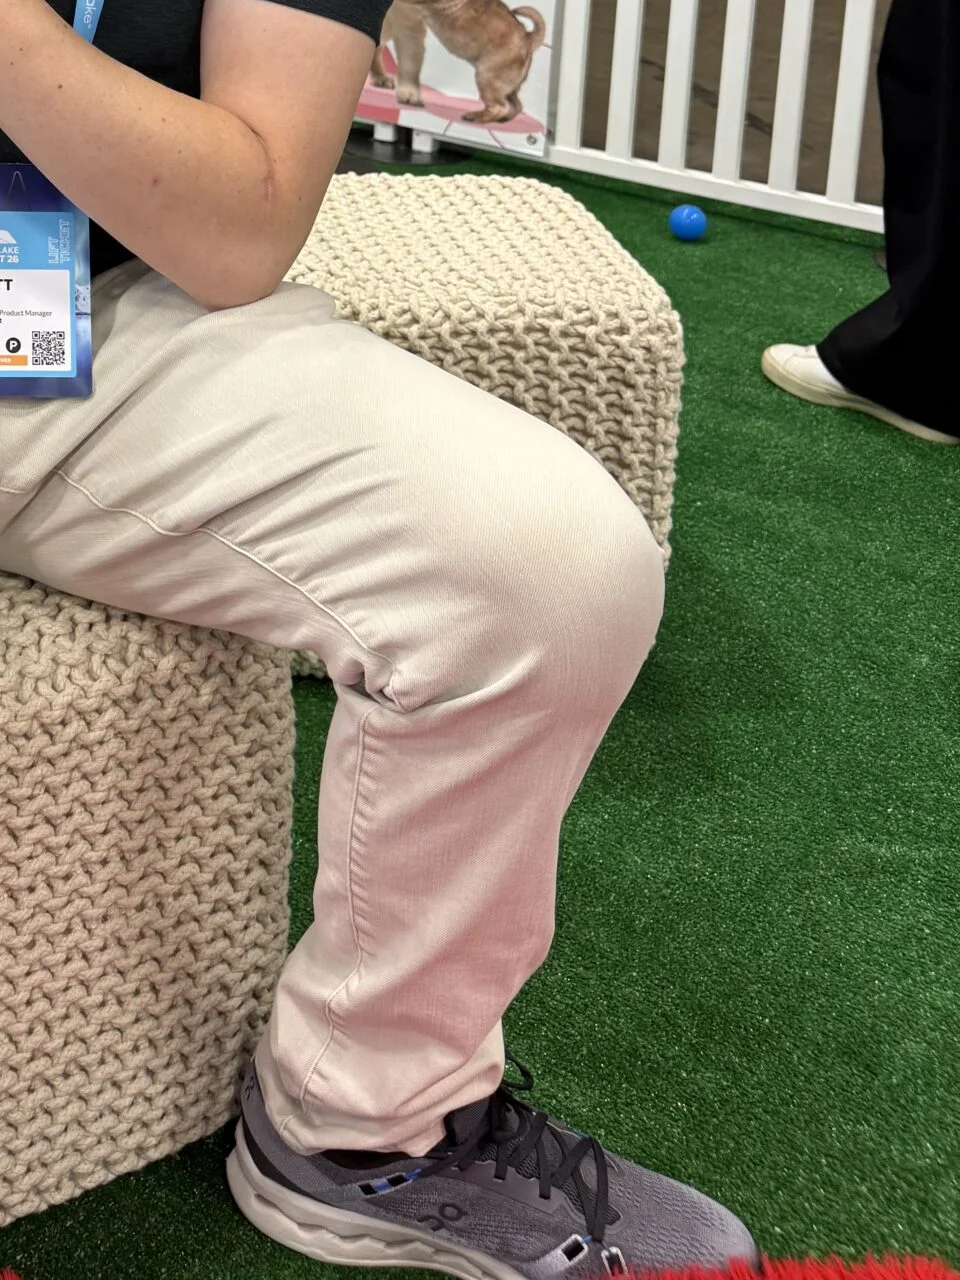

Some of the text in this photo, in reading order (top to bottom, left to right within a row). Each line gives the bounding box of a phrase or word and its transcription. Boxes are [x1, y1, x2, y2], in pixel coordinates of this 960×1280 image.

[48, 236, 59, 264] LIFT
[59, 219, 70, 264] TICKET
[7, 255, 20, 263] 26
[0, 309, 24, 317] Product
[25, 310, 53, 318] Manager
